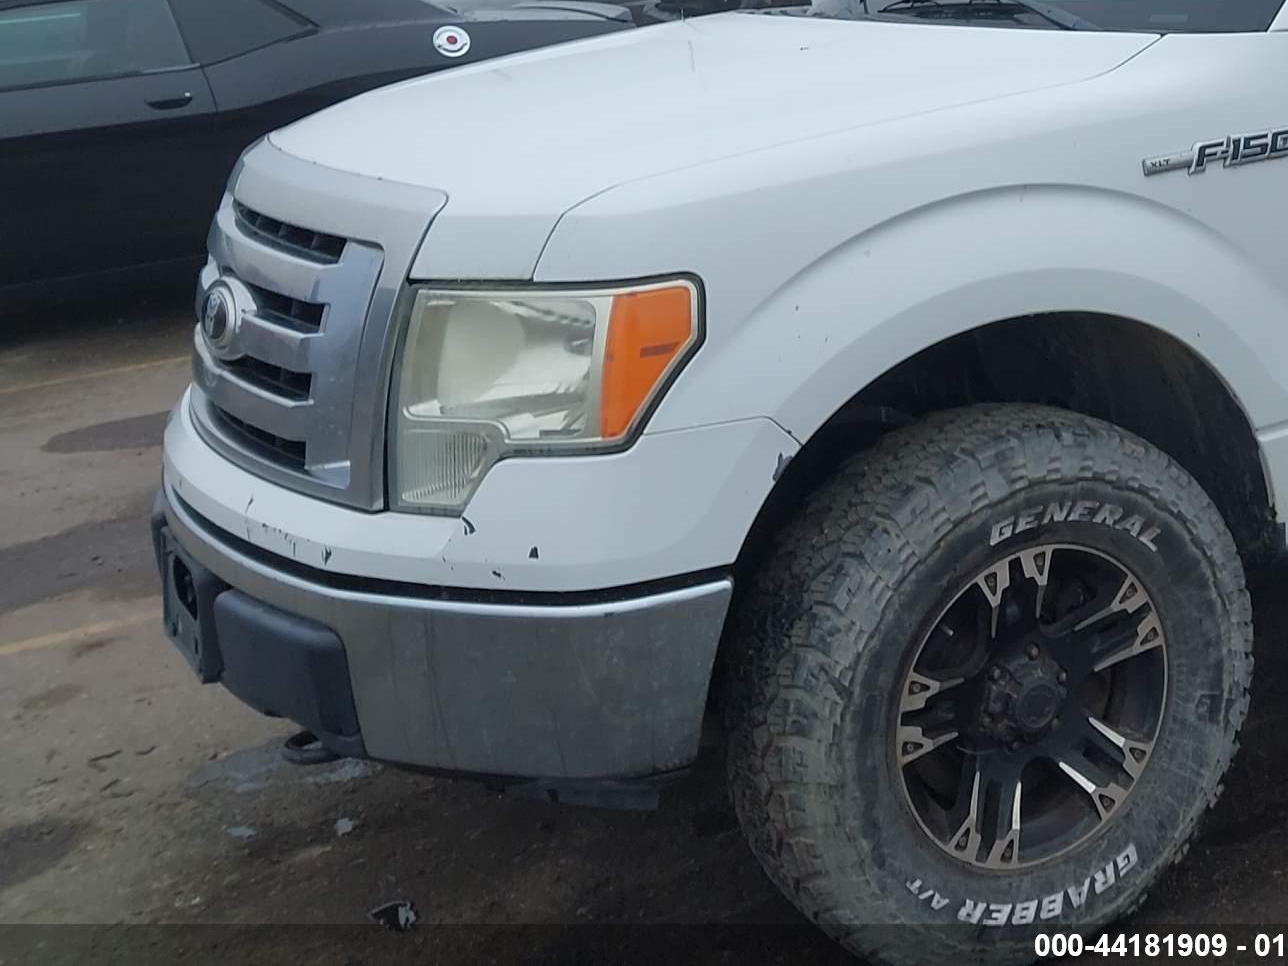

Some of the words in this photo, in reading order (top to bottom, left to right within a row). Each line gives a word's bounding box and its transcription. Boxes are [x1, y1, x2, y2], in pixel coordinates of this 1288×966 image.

[989, 499, 1161, 552] GENERAL
[905, 879, 950, 910] A/T
[956, 842, 1138, 927] GRABBER
